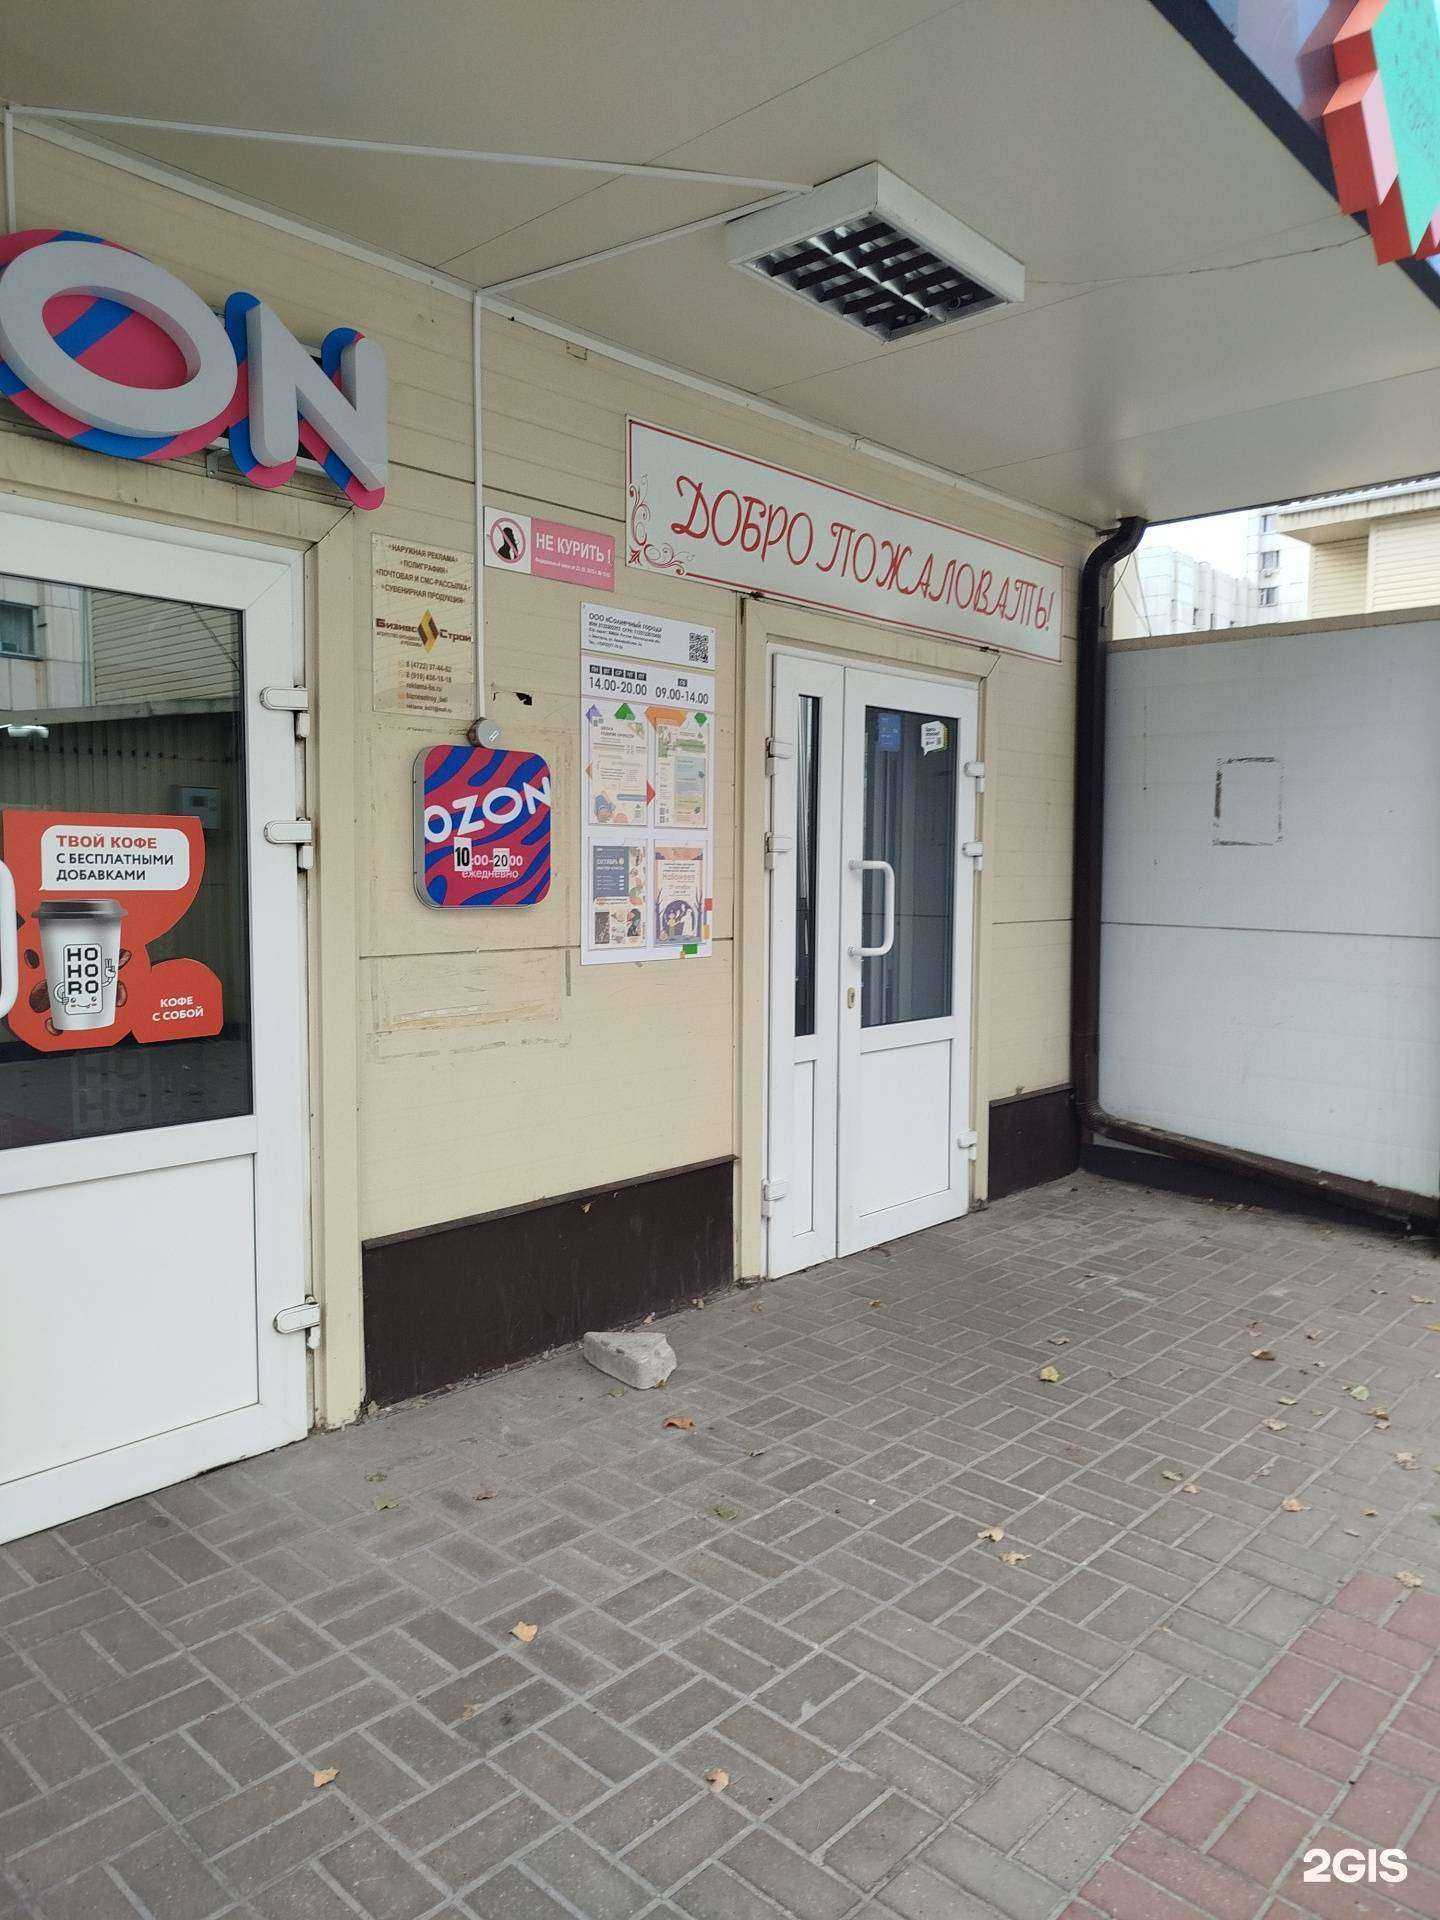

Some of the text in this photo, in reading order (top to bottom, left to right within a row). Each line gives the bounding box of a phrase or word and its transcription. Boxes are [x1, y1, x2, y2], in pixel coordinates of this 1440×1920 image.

[536, 532, 554, 551] НЕ
[557, 537, 604, 562] КУРИТЬ
[671, 475, 1055, 631] ДОБРО ПОЖАЛОВАТЬ!
[589, 613, 604, 621] ООО
[376, 618, 417, 633] Бизнес
[590, 677, 647, 696] 14.00-20.00
[656, 687, 709, 705] 09.00-14.00
[424, 776, 552, 843] OZON
[56, 833, 158, 849] ТВОЙ КОФЕ
[56, 853, 174, 866] С БЕСПЛАТНЫМИ
[56, 869, 146, 882] ДОБАВКАМИ
[462, 869, 519, 879] ежедневно
[160, 996, 194, 1008] КОФЕ
[152, 1006, 204, 1022] С СОБОЙ
